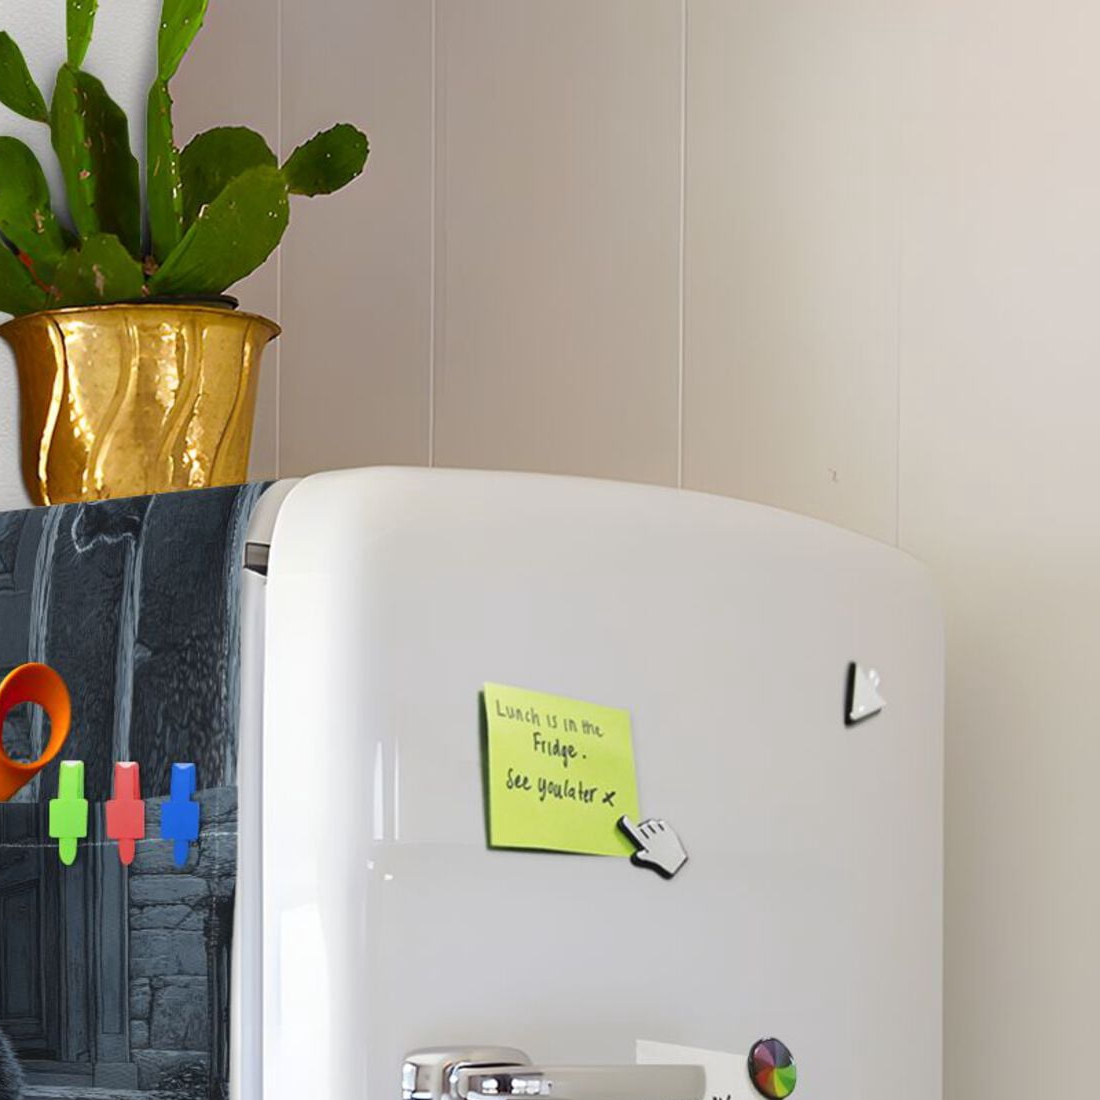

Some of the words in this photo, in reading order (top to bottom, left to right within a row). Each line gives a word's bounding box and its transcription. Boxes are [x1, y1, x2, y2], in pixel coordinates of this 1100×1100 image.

[496, 699, 540, 727] Lunch
[564, 719, 578, 732] in
[582, 720, 604, 737] the
[506, 768, 532, 791] See
